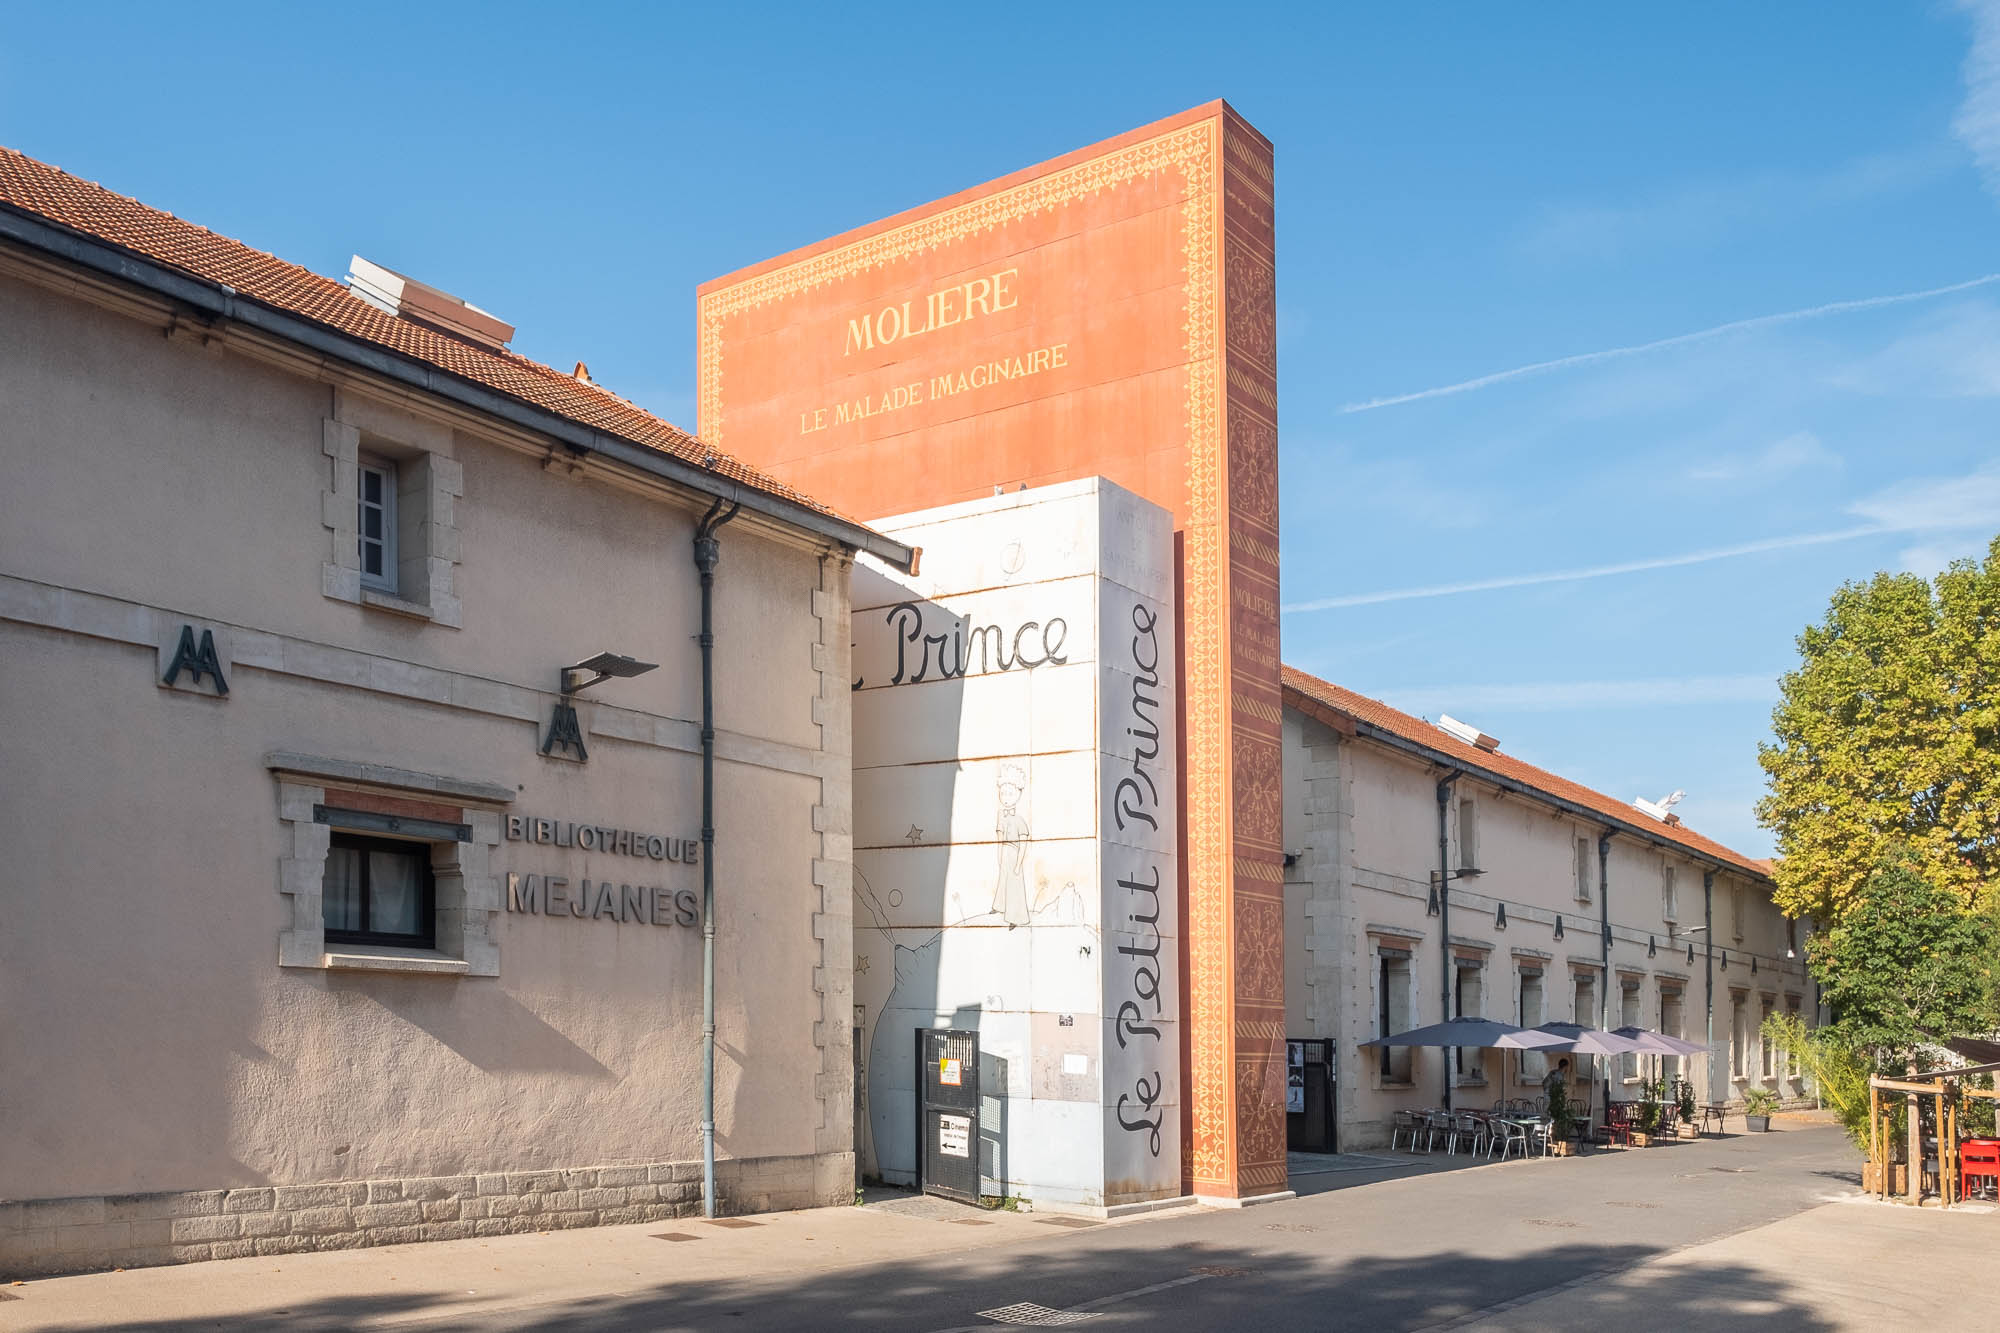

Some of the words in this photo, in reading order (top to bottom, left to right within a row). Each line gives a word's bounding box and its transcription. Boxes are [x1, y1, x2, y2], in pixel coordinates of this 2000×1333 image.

[844, 268, 1018, 356] MOLIERE
[799, 408, 828, 435] LE
[834, 382, 923, 426] MALADE
[929, 344, 1068, 401] IMAGINAIRE
[886, 602, 1068, 686] Prince
[1114, 603, 1159, 832] Prince
[505, 813, 699, 865] BIBLIOTHEQUE
[506, 871, 699, 929] MEJANES
[1115, 866, 1161, 1050] Petit
[1117, 1071, 1162, 1158] Le
